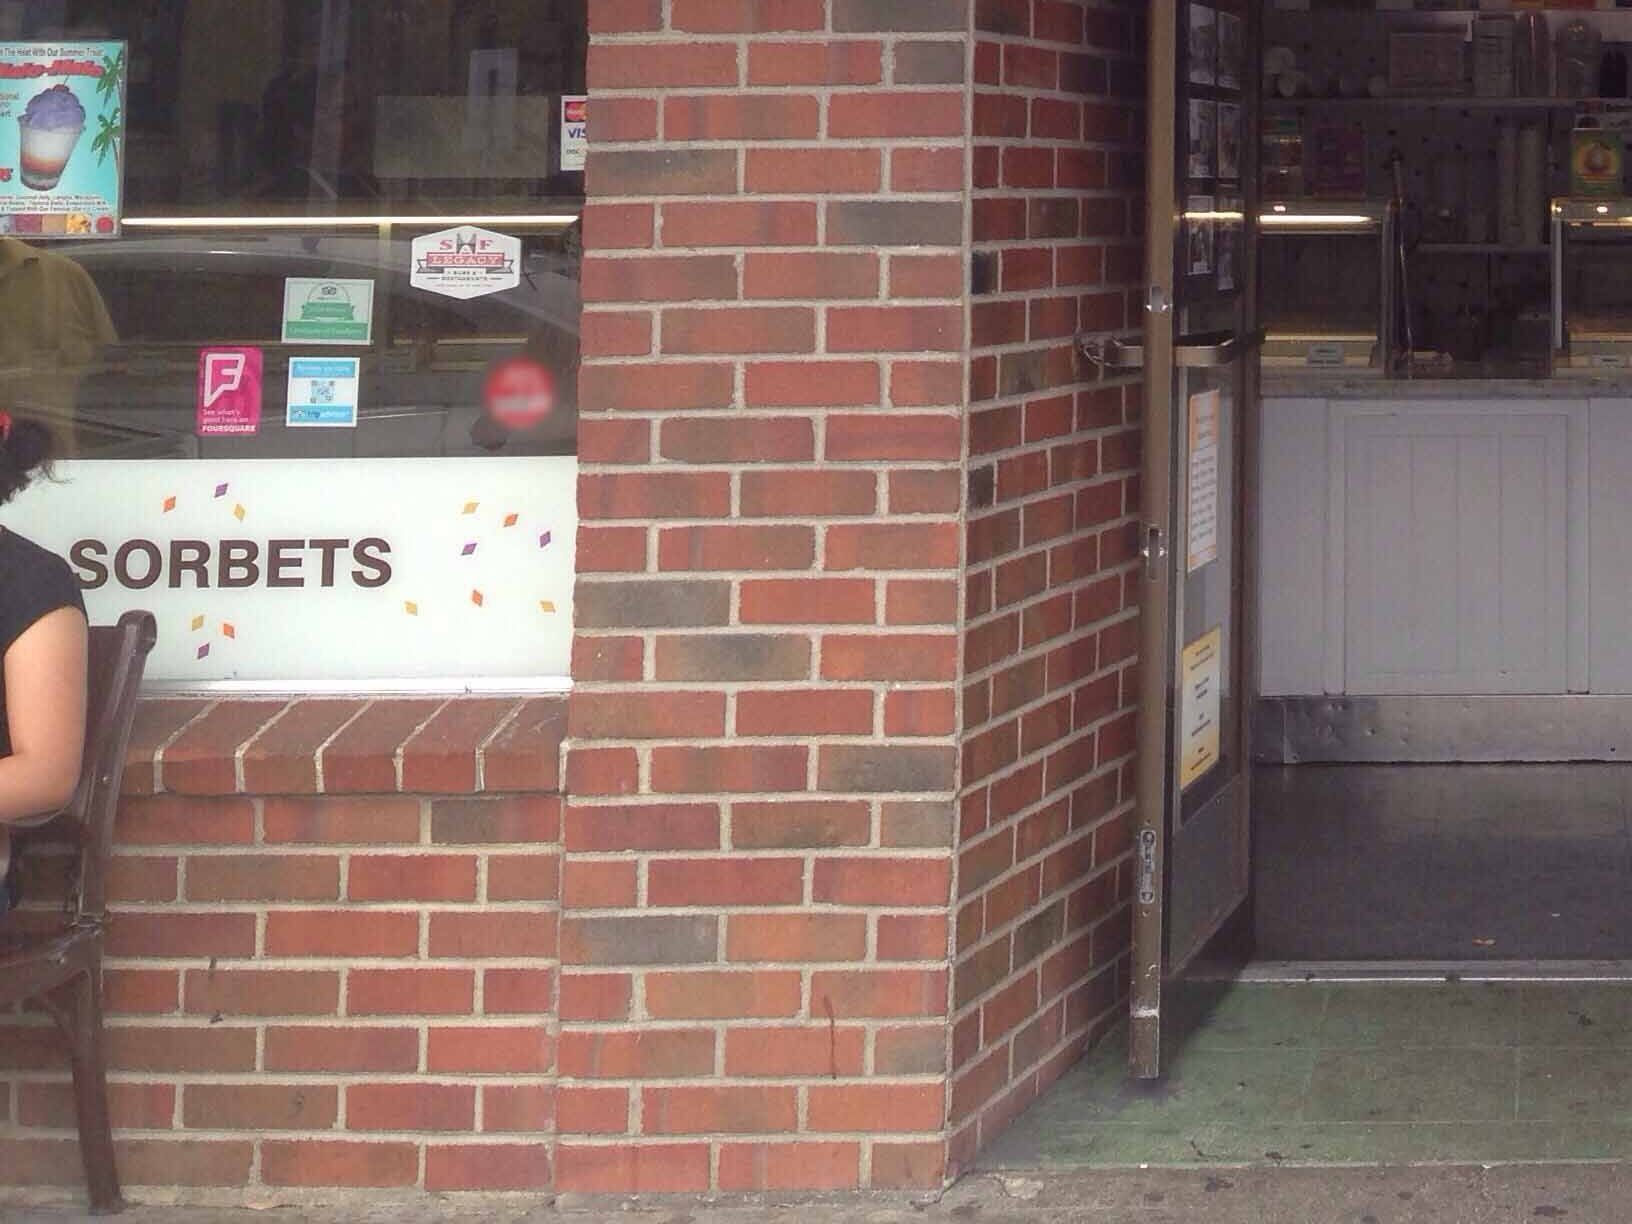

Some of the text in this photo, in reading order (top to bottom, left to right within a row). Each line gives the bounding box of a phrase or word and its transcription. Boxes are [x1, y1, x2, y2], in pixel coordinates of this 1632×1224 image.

[431, 255, 499, 265] LEGACY
[202, 425, 256, 433] FOURSQUARE
[70, 537, 393, 590] SORBETS
